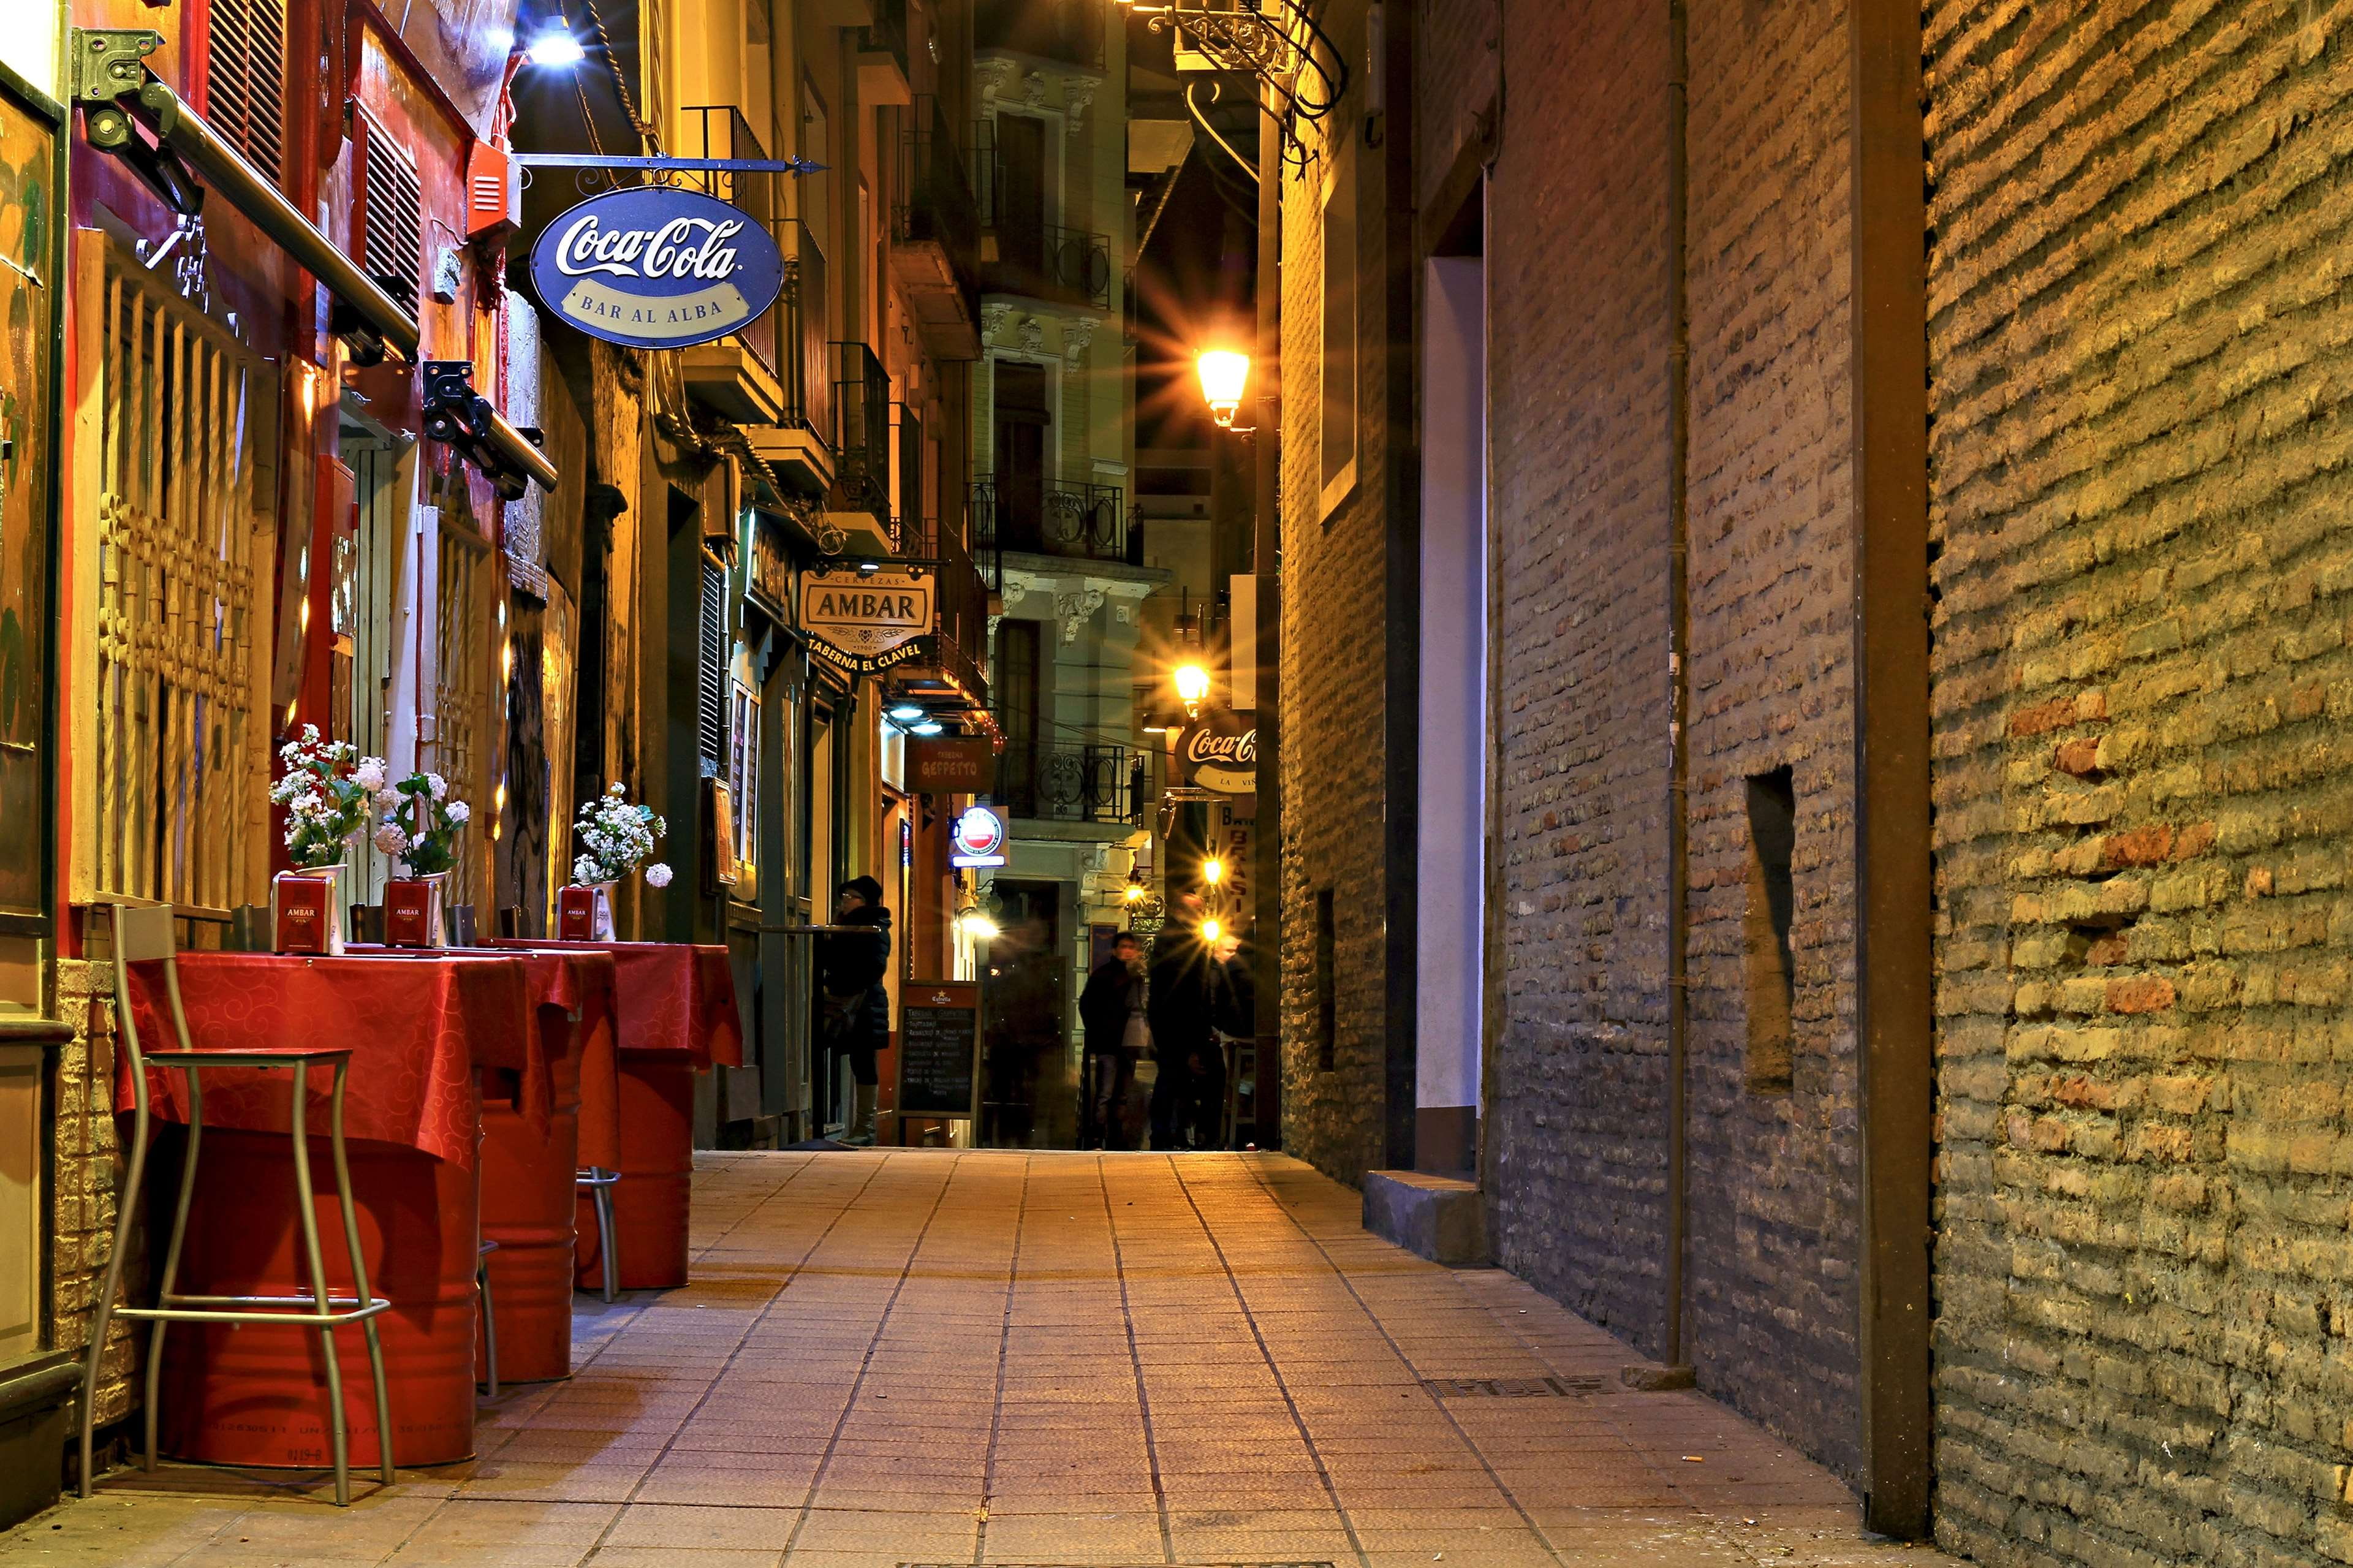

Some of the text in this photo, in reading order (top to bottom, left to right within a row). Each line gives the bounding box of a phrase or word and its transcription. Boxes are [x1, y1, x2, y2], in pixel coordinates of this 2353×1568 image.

[556, 214, 745, 279] Coca-Cola
[580, 295, 722, 323] BAR AL ALBA
[835, 576, 900, 585] CERVEZAS
[816, 593, 917, 619] AMBAR
[808, 638, 921, 672] TABERNA EL CLAVEL
